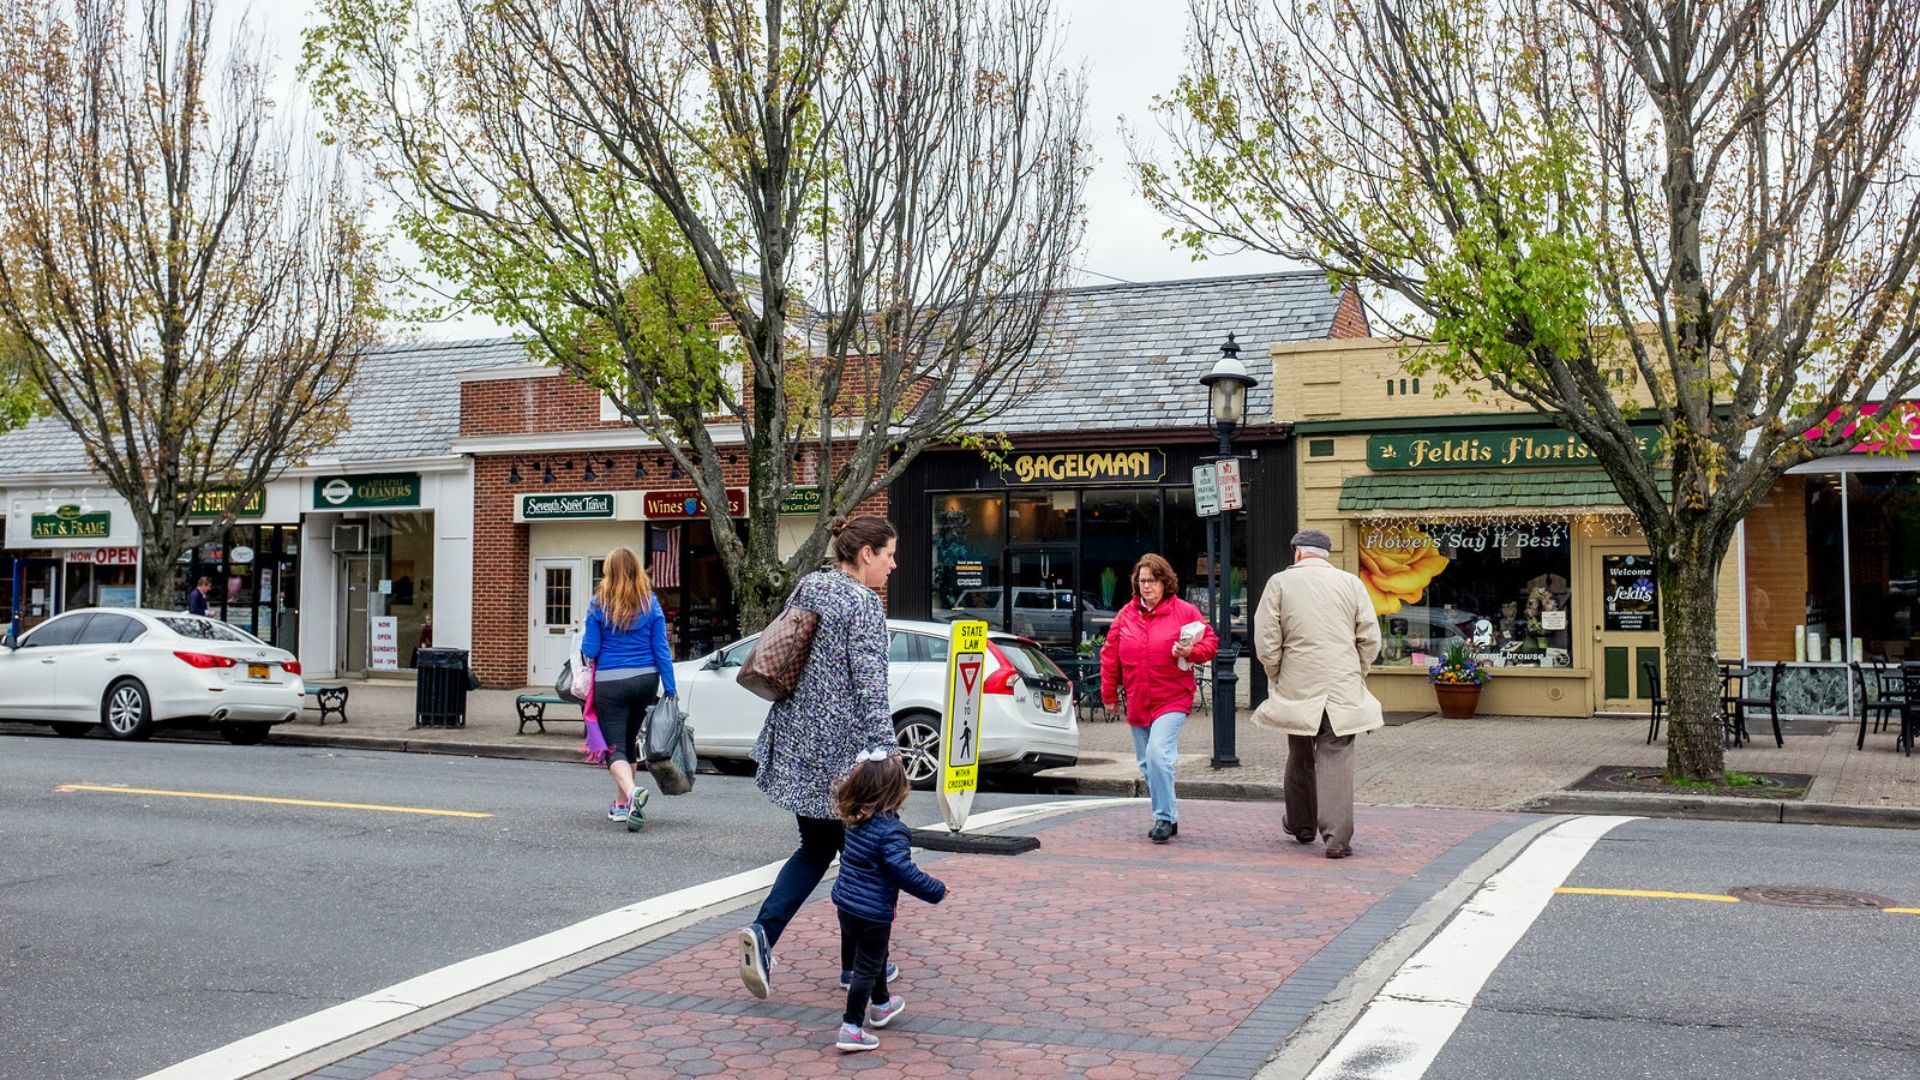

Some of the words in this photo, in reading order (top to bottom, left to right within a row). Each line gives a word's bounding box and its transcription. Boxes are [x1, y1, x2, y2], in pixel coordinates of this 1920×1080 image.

[1408, 439, 1492, 467] Feldis
[1014, 452, 1150, 482] BAGELMAN
[357, 484, 412, 498] CLEANERS
[527, 498, 560, 514] Seventh
[560, 497, 583, 513] Street
[583, 496, 608, 510] Travel
[648, 499, 683, 513] Wines
[35, 521, 56, 535] ART
[58, 521, 68, 535] &
[70, 519, 106, 534] FRAME
[1366, 535, 1442, 549] Flowers
[1448, 533, 1487, 552] Say
[1492, 533, 1509, 548] It
[1515, 532, 1561, 548] Best
[70, 551, 92, 561] NOW
[95, 547, 138, 563] OPEN
[1609, 567, 1652, 576] Welcome
[1606, 586, 1653, 602] feldis
[961, 625, 983, 637] STATE
[964, 638, 980, 650] LAW
[963, 705, 972, 716] TO
[955, 768, 971, 777] WITHIN
[947, 779, 975, 789] CROSSWALK
